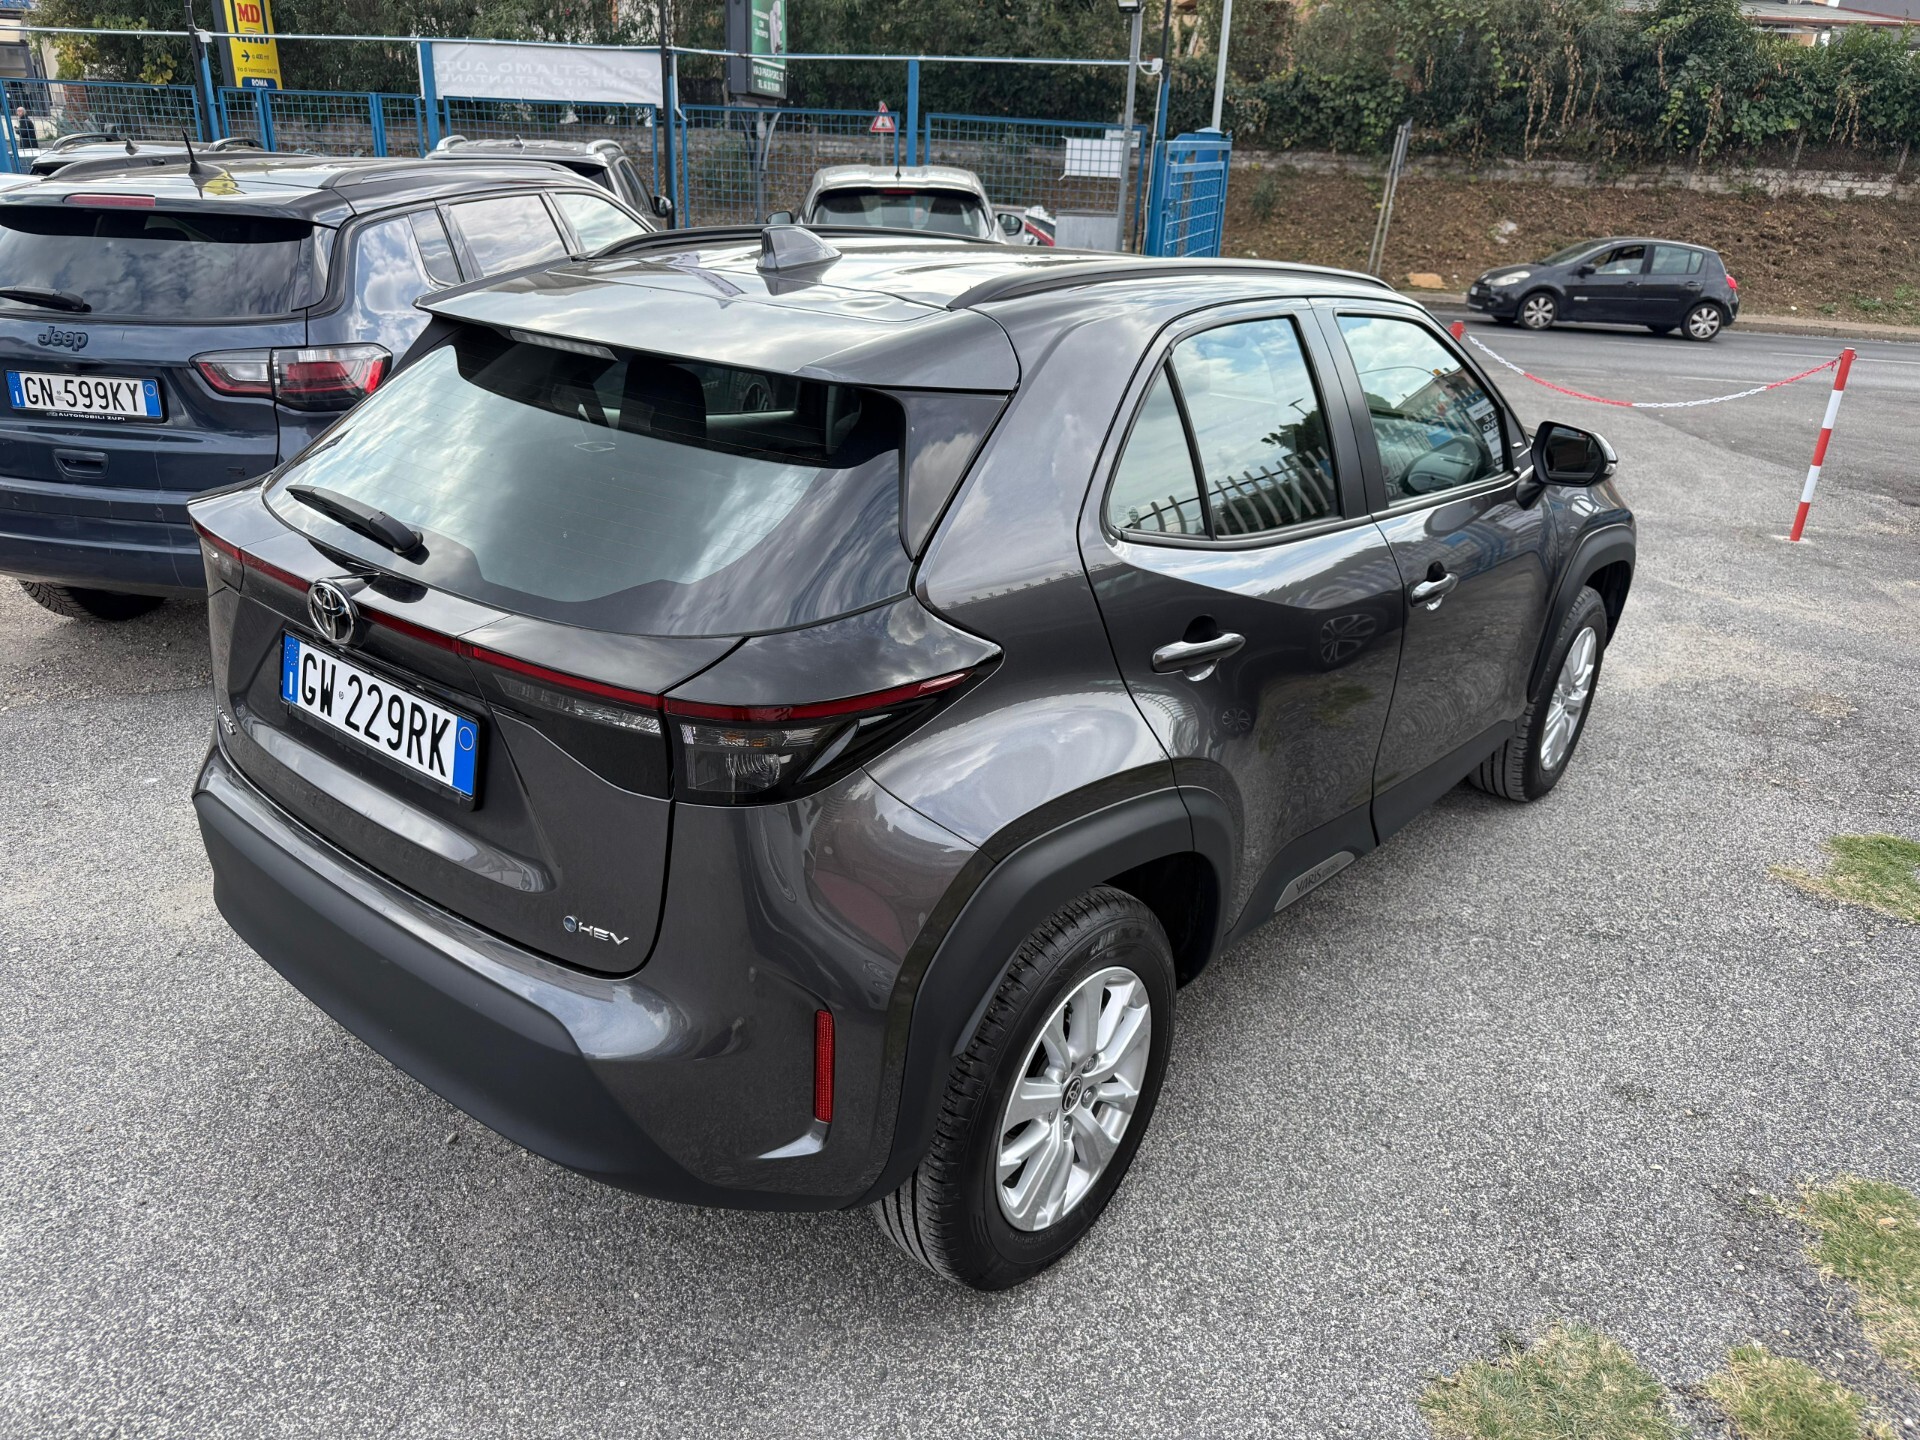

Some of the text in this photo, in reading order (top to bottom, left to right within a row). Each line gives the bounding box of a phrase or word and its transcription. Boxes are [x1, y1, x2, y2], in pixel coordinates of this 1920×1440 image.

[237, 3, 260, 23] MD
[251, 79, 268, 87] ROMA
[37, 325, 89, 352] Jeep
[58, 412, 105, 420] AUTOMOBILI
[1296, 868, 1321, 894] YARIS
[578, 921, 630, 946] HEV
